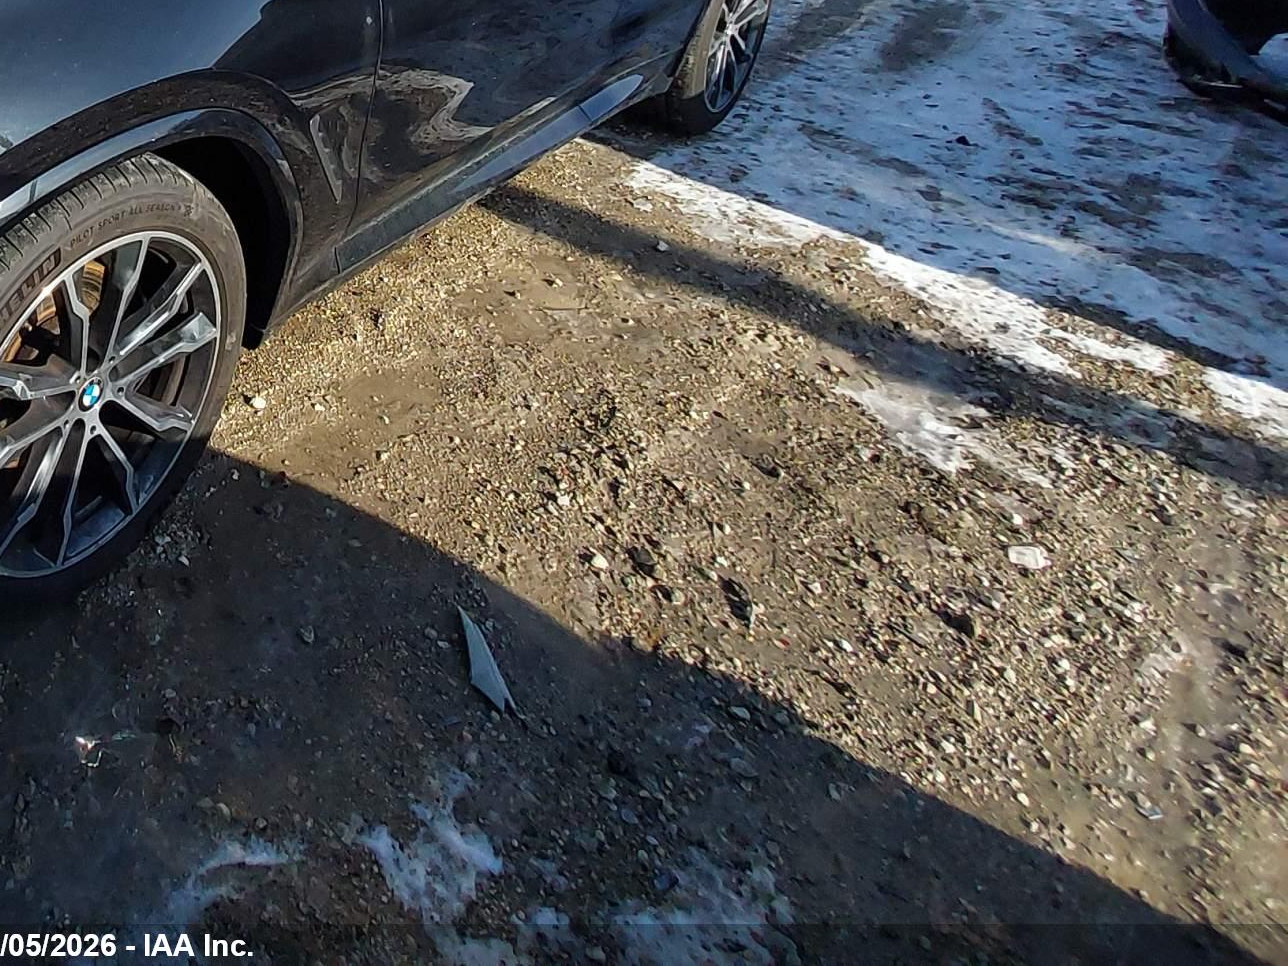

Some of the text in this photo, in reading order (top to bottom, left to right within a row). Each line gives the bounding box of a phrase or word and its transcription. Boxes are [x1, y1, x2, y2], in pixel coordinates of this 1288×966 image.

[69, 227, 96, 248] PILOT
[98, 209, 126, 229] SPORT
[127, 204, 144, 216] ALL
